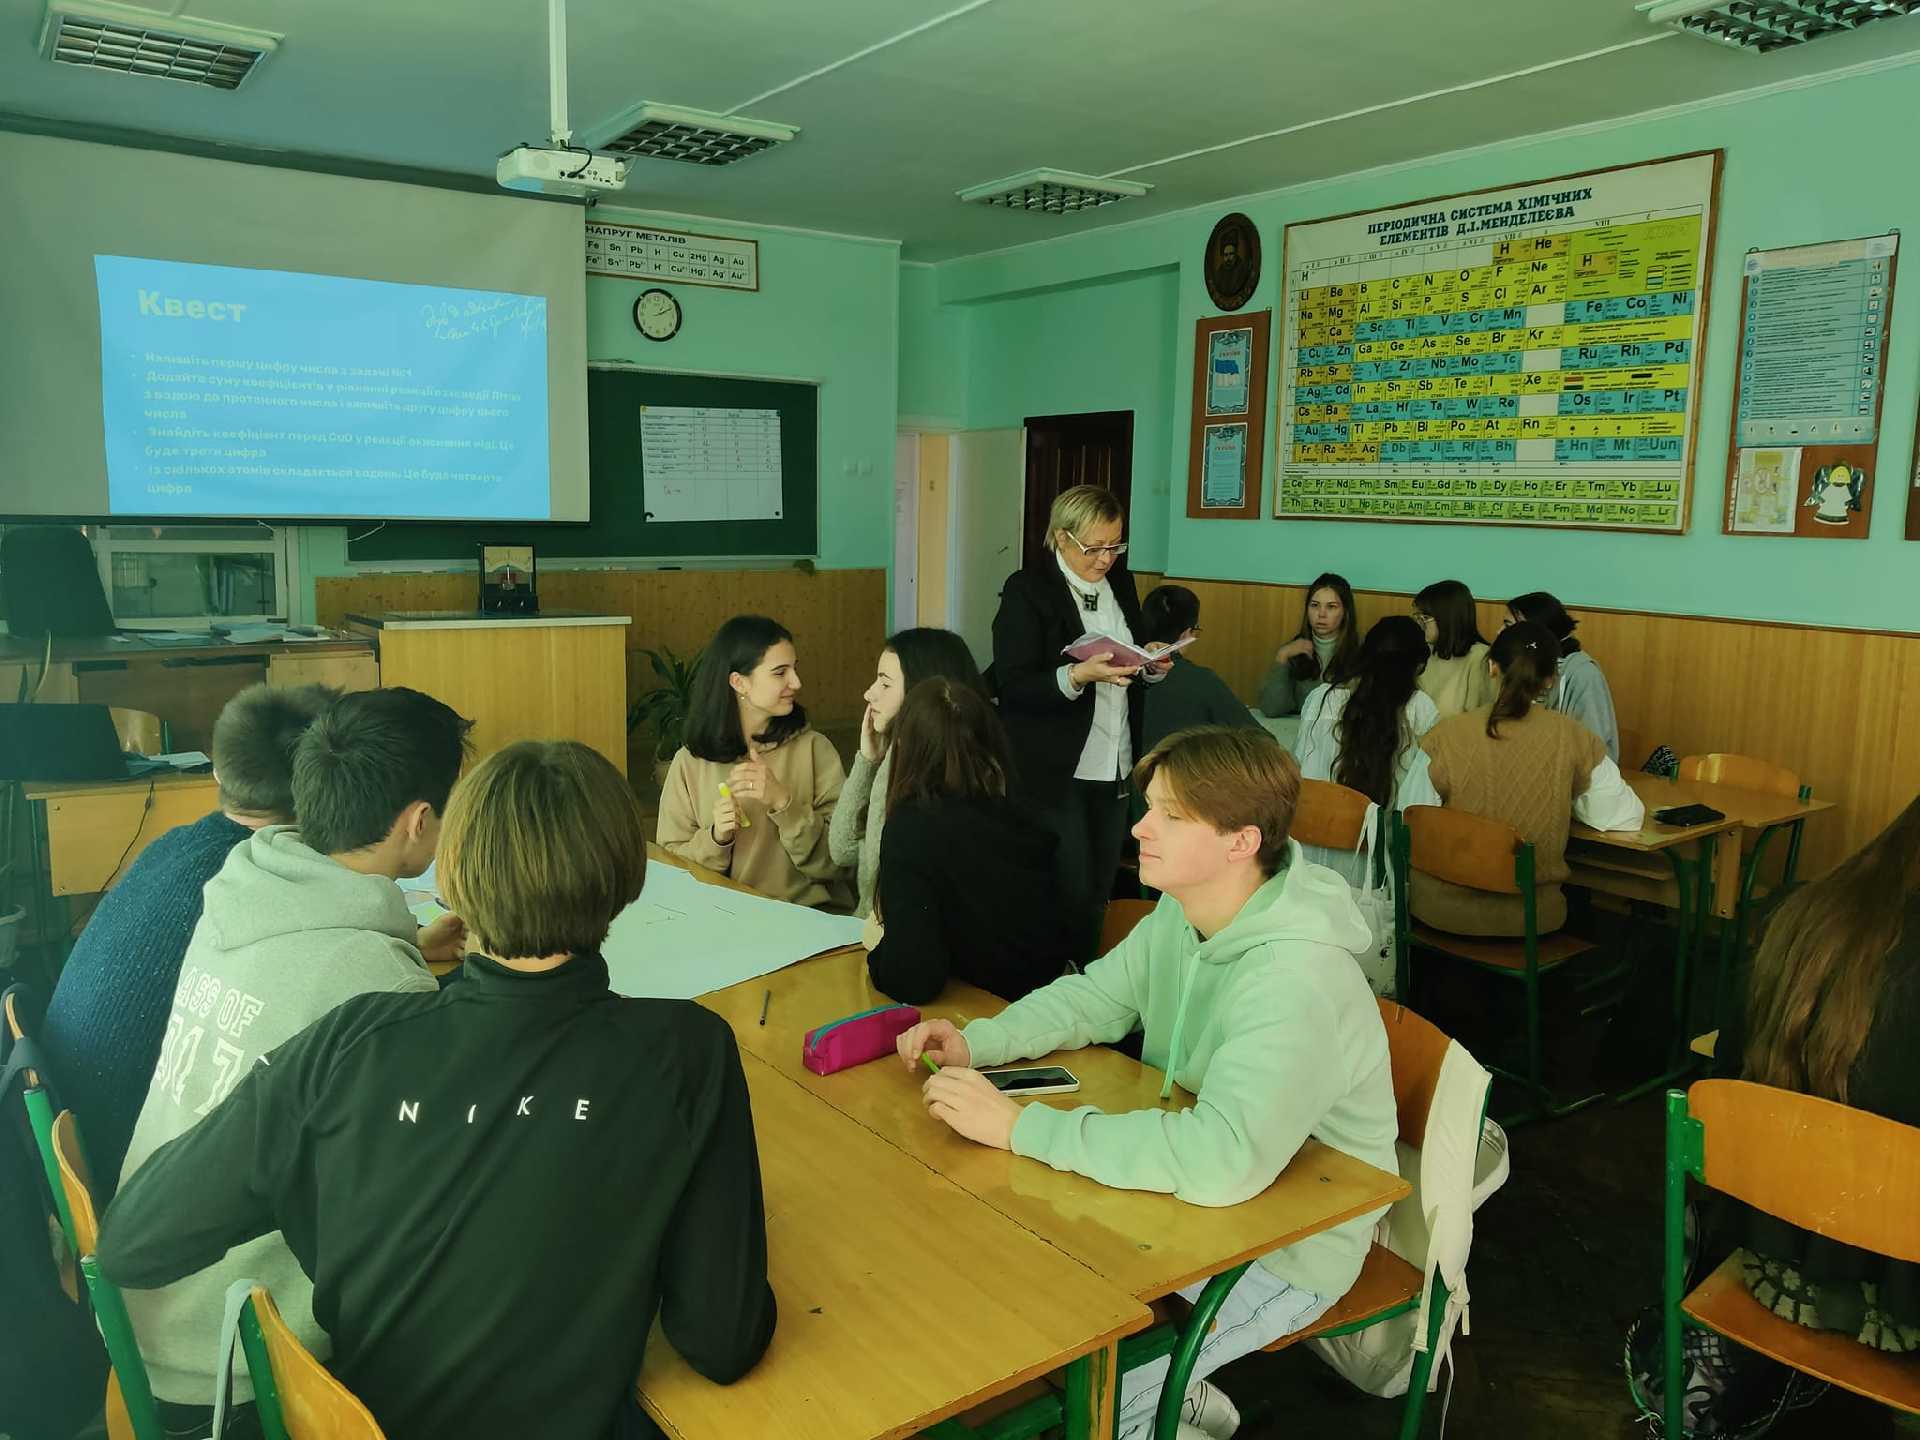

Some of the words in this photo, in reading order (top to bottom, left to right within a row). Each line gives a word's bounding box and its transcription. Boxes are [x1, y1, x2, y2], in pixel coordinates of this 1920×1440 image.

[1368, 212, 1445, 234] ПЕРІОДИЧНА
[1451, 200, 1513, 221] СИСТЕМА
[1519, 188, 1592, 209] ХІМІЧНИХ
[636, 232, 686, 244] МЕТАЛІВ
[1380, 225, 1448, 245] ЕЛЕМЕНТІВ
[631, 246, 643, 254] Pb
[713, 256, 724, 264] Ag
[1302, 272, 1308, 281] H
[1500, 244, 1509, 254] H
[1535, 239, 1552, 249] He
[1331, 288, 1343, 297] Be
[1361, 284, 1367, 293] B
[1393, 280, 1399, 288] C
[1425, 276, 1433, 285] N
[1460, 271, 1469, 281] O
[1497, 267, 1503, 276] F
[1531, 262, 1548, 272] Ne
[137, 289, 247, 322] Квест
[1329, 308, 1343, 317] Mg
[1360, 305, 1370, 313] Al
[1392, 300, 1401, 309] Si
[1462, 293, 1469, 302] S
[1495, 288, 1506, 299] Cl
[1531, 285, 1547, 294] Ar
[1330, 328, 1341, 336] Ca
[1441, 316, 1449, 326] V
[1470, 313, 1484, 323] Cr
[1504, 310, 1521, 320] Mn
[1586, 302, 1602, 312] Fe
[1627, 298, 1646, 308] Co
[1673, 293, 1687, 304] Ni
[1337, 346, 1350, 355] Zn
[1359, 344, 1372, 353] Ga
[1391, 342, 1404, 350] Ge
[1422, 339, 1436, 348] As
[1456, 336, 1470, 345] Se
[1493, 333, 1506, 343] Br
[1529, 330, 1544, 340] Kr
[1301, 369, 1312, 377] Rb
[1329, 367, 1338, 375] Sr
[1431, 360, 1446, 368] Nb
[1461, 357, 1478, 366] Mo
[1579, 348, 1597, 359] Ru
[1621, 345, 1640, 356] Rh
[1665, 342, 1683, 353] Pd
[1388, 383, 1400, 391] Sn
[1419, 381, 1432, 390] Sb
[1455, 378, 1467, 388] Te
[1526, 375, 1541, 384] Xe
[1299, 407, 1310, 416] Cs
[1326, 406, 1337, 415] Ba
[1366, 405, 1378, 413] La
[1431, 401, 1442, 410] Ta
[1467, 399, 1478, 408] W
[1573, 394, 1591, 405] Os
[1624, 392, 1634, 403] Ir
[1664, 390, 1680, 401] Pt
[1305, 426, 1318, 435] Au
[1385, 424, 1397, 432] Pb
[1418, 422, 1428, 432] Bi
[1451, 421, 1465, 431] Po
[1486, 420, 1499, 430] At
[1523, 419, 1539, 428] Rn
[1363, 444, 1376, 453] Ac
[1412, 481, 1424, 489] Eu
[1622, 482, 1636, 491] Yb
[217, 988, 265, 1038] OF
[398, 1095, 590, 1125] NIKE
